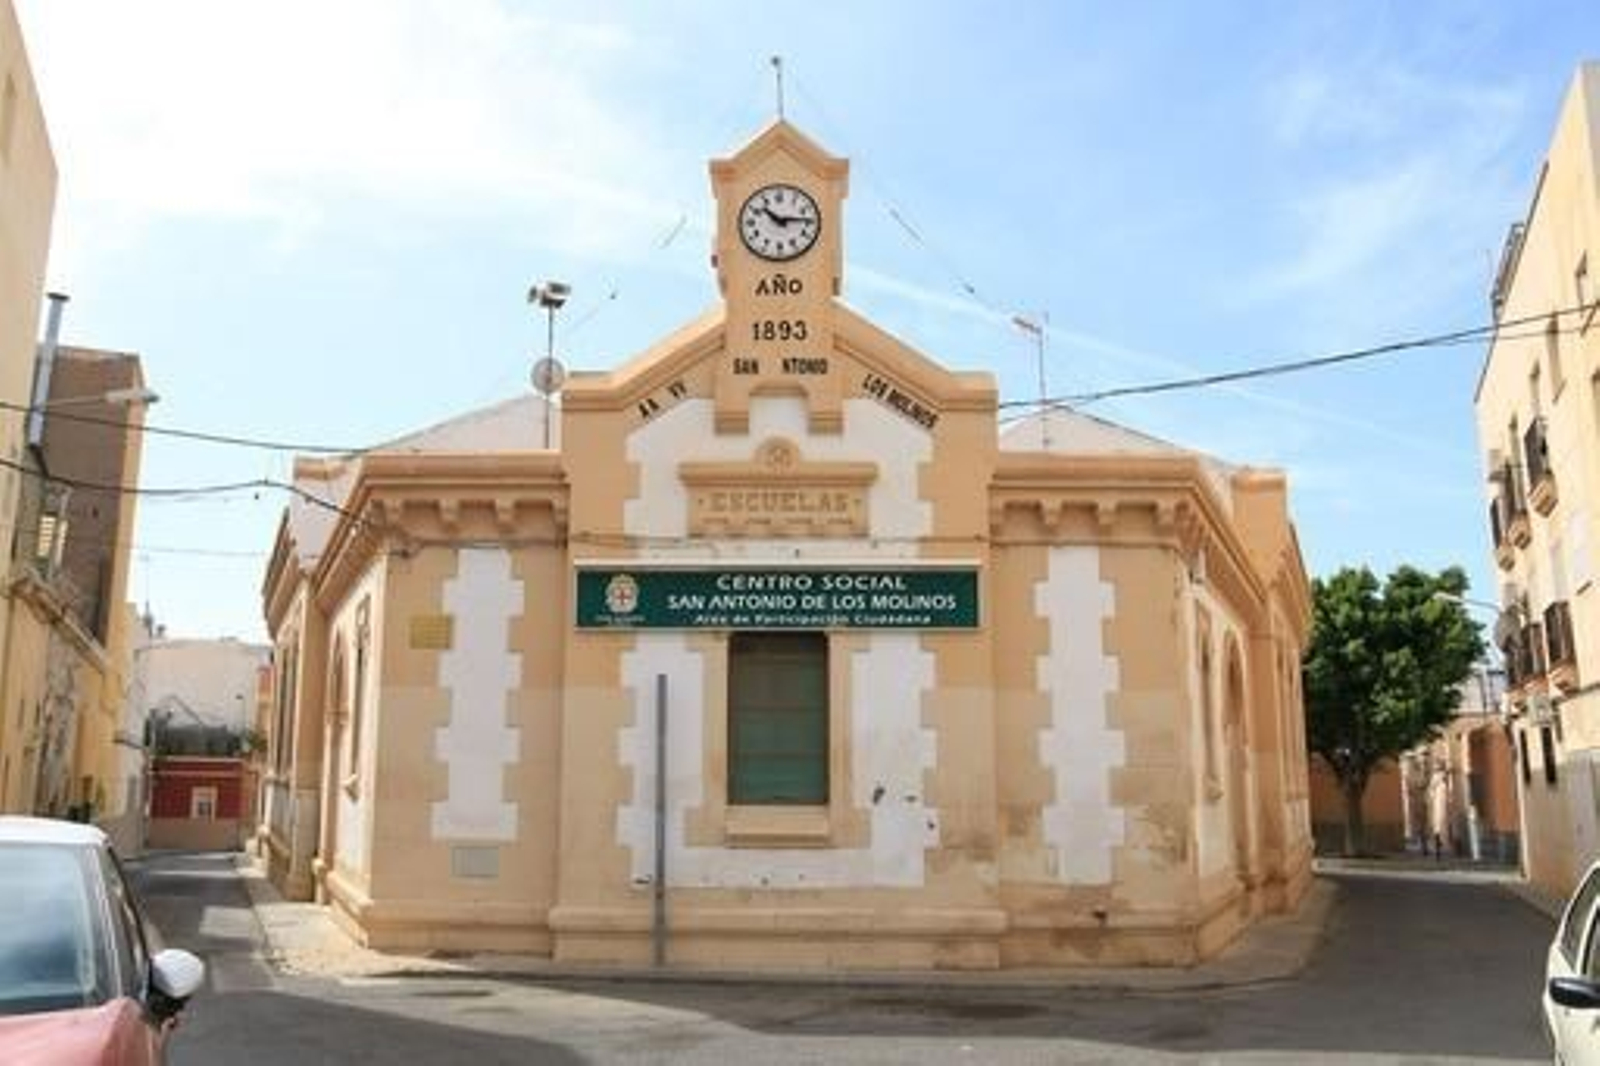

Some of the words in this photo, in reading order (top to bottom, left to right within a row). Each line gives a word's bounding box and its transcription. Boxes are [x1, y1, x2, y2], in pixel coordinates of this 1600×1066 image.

[755, 273, 803, 296] AÑO
[753, 319, 807, 341] 1893
[733, 358, 759, 374] SAN
[863, 373, 888, 397] LOS
[886, 389, 938, 428] MOLINOS
[710, 492, 847, 512] ESCUELAS
[717, 575, 813, 590] CENTRO
[822, 575, 907, 590] SOCIAL
[667, 595, 704, 609] SAN
[708, 595, 797, 609] ANTONIO
[802, 595, 826, 609] DE
[833, 595, 866, 609] LOS
[871, 595, 956, 609] MOLINOS
[733, 613, 750, 623] de
